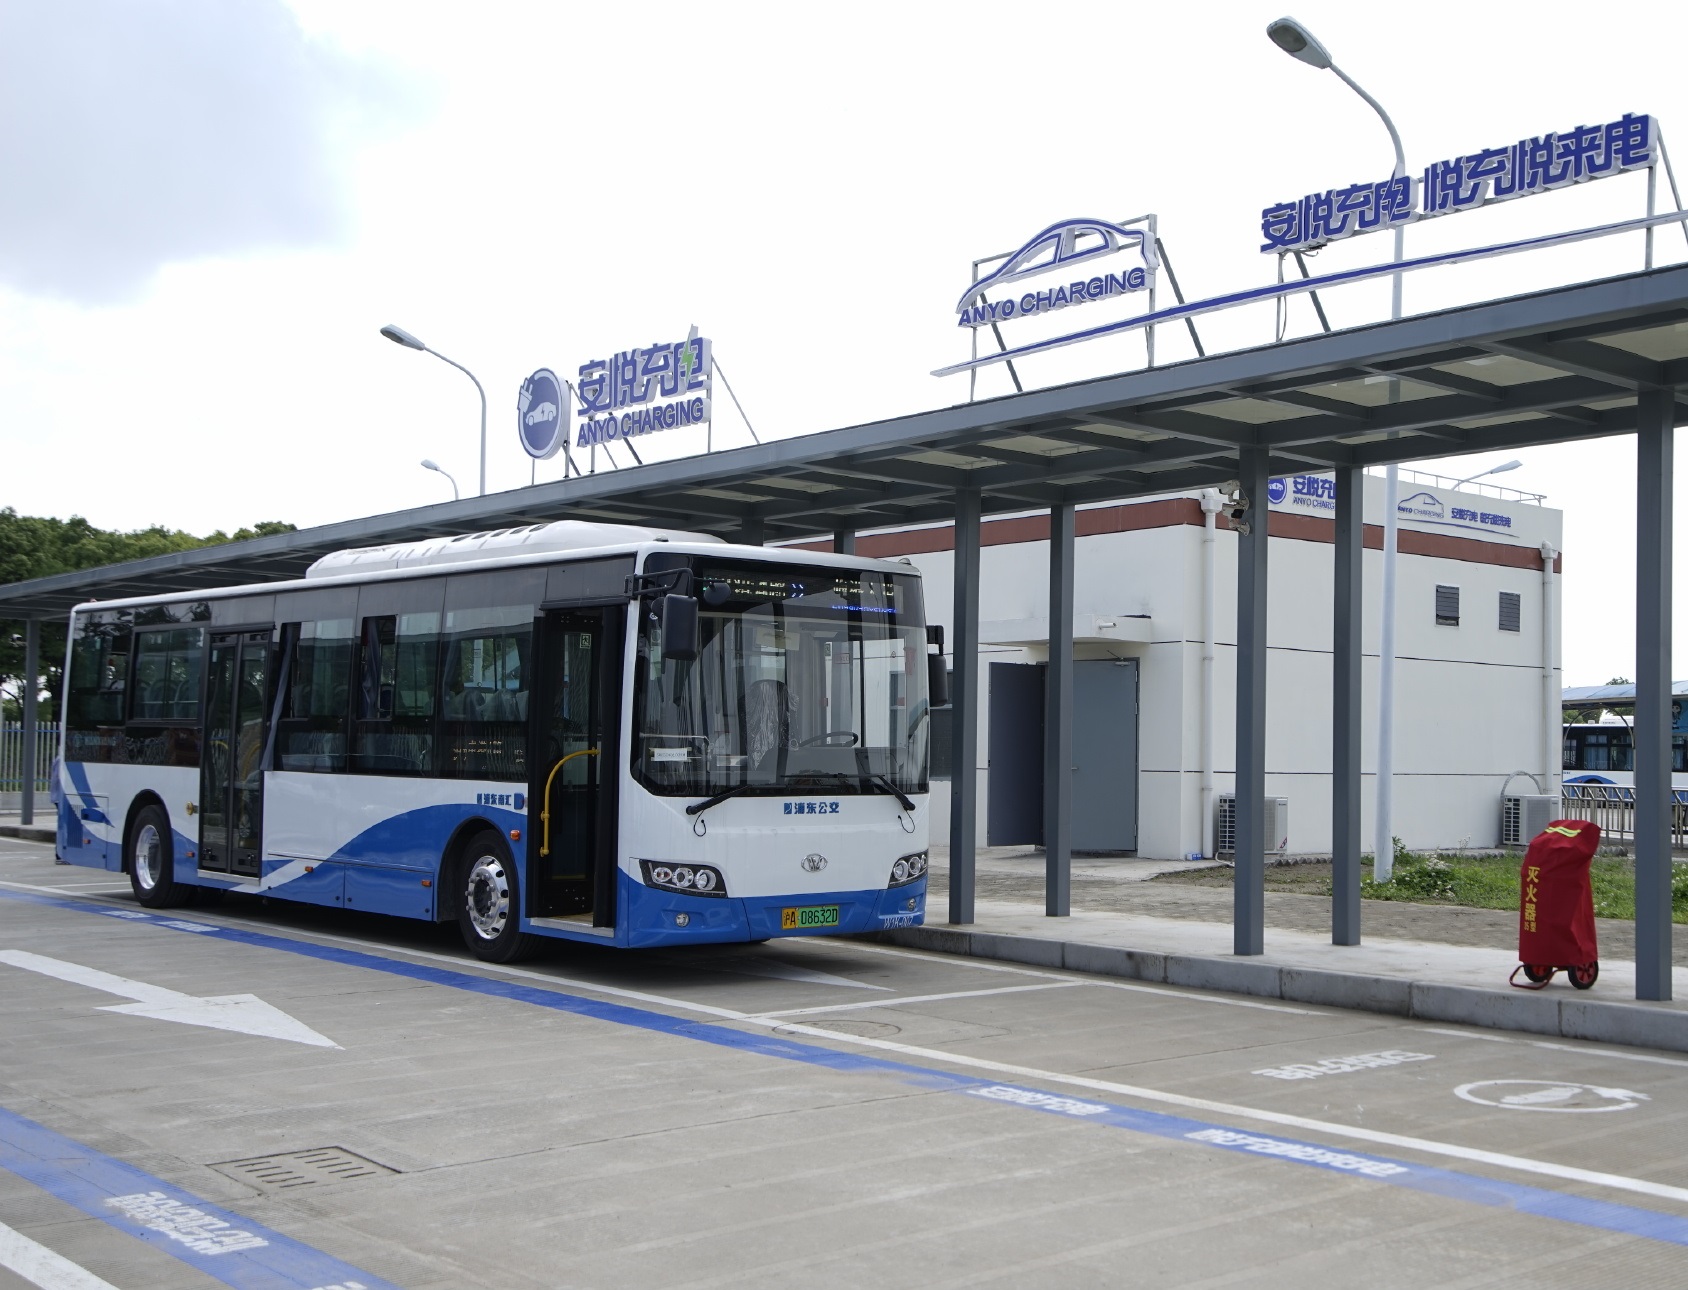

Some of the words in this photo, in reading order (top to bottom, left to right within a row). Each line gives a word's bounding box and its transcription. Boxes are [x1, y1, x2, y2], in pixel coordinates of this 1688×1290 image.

[1260, 172, 1412, 252] 安悦充电
[1423, 113, 1651, 214] 悦充悦来电
[958, 299, 1015, 327] ANYO
[1020, 267, 1146, 315] CHARGING
[578, 327, 708, 417] 安悦充电
[577, 418, 618, 447] ANYO
[620, 397, 705, 438] CHARGING
[1293, 475, 1336, 499] 安悦充
[793, 802, 839, 814] 浦东公交
[1525, 866, 1540, 922] 灭火器
